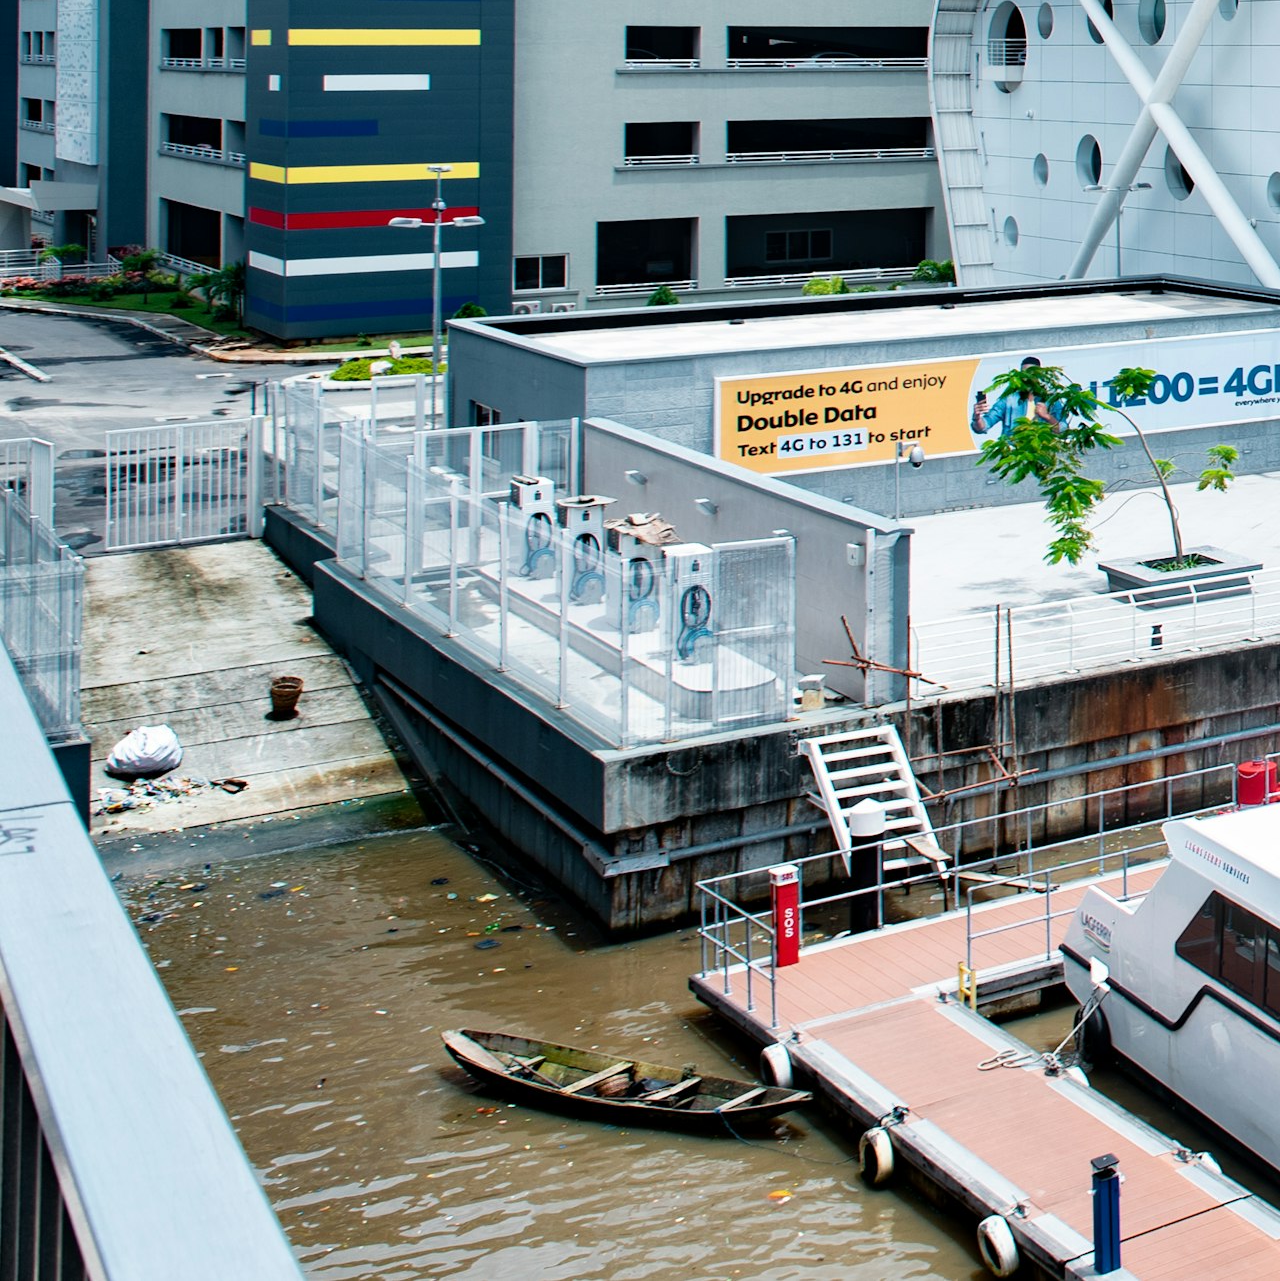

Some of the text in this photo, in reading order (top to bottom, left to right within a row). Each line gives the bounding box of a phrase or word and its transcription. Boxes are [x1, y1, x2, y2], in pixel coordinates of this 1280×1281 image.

[736, 374, 947, 407] Upgrade to 4G and enjoy
[1234, 397, 1276, 407] everywhere
[737, 404, 877, 432] Double Data
[737, 425, 931, 457] Text 4G to 131 to start
[1222, 861, 1251, 885] SERVICES
[783, 907, 795, 938] SOS
[1080, 910, 1113, 944] LAGFERRY
